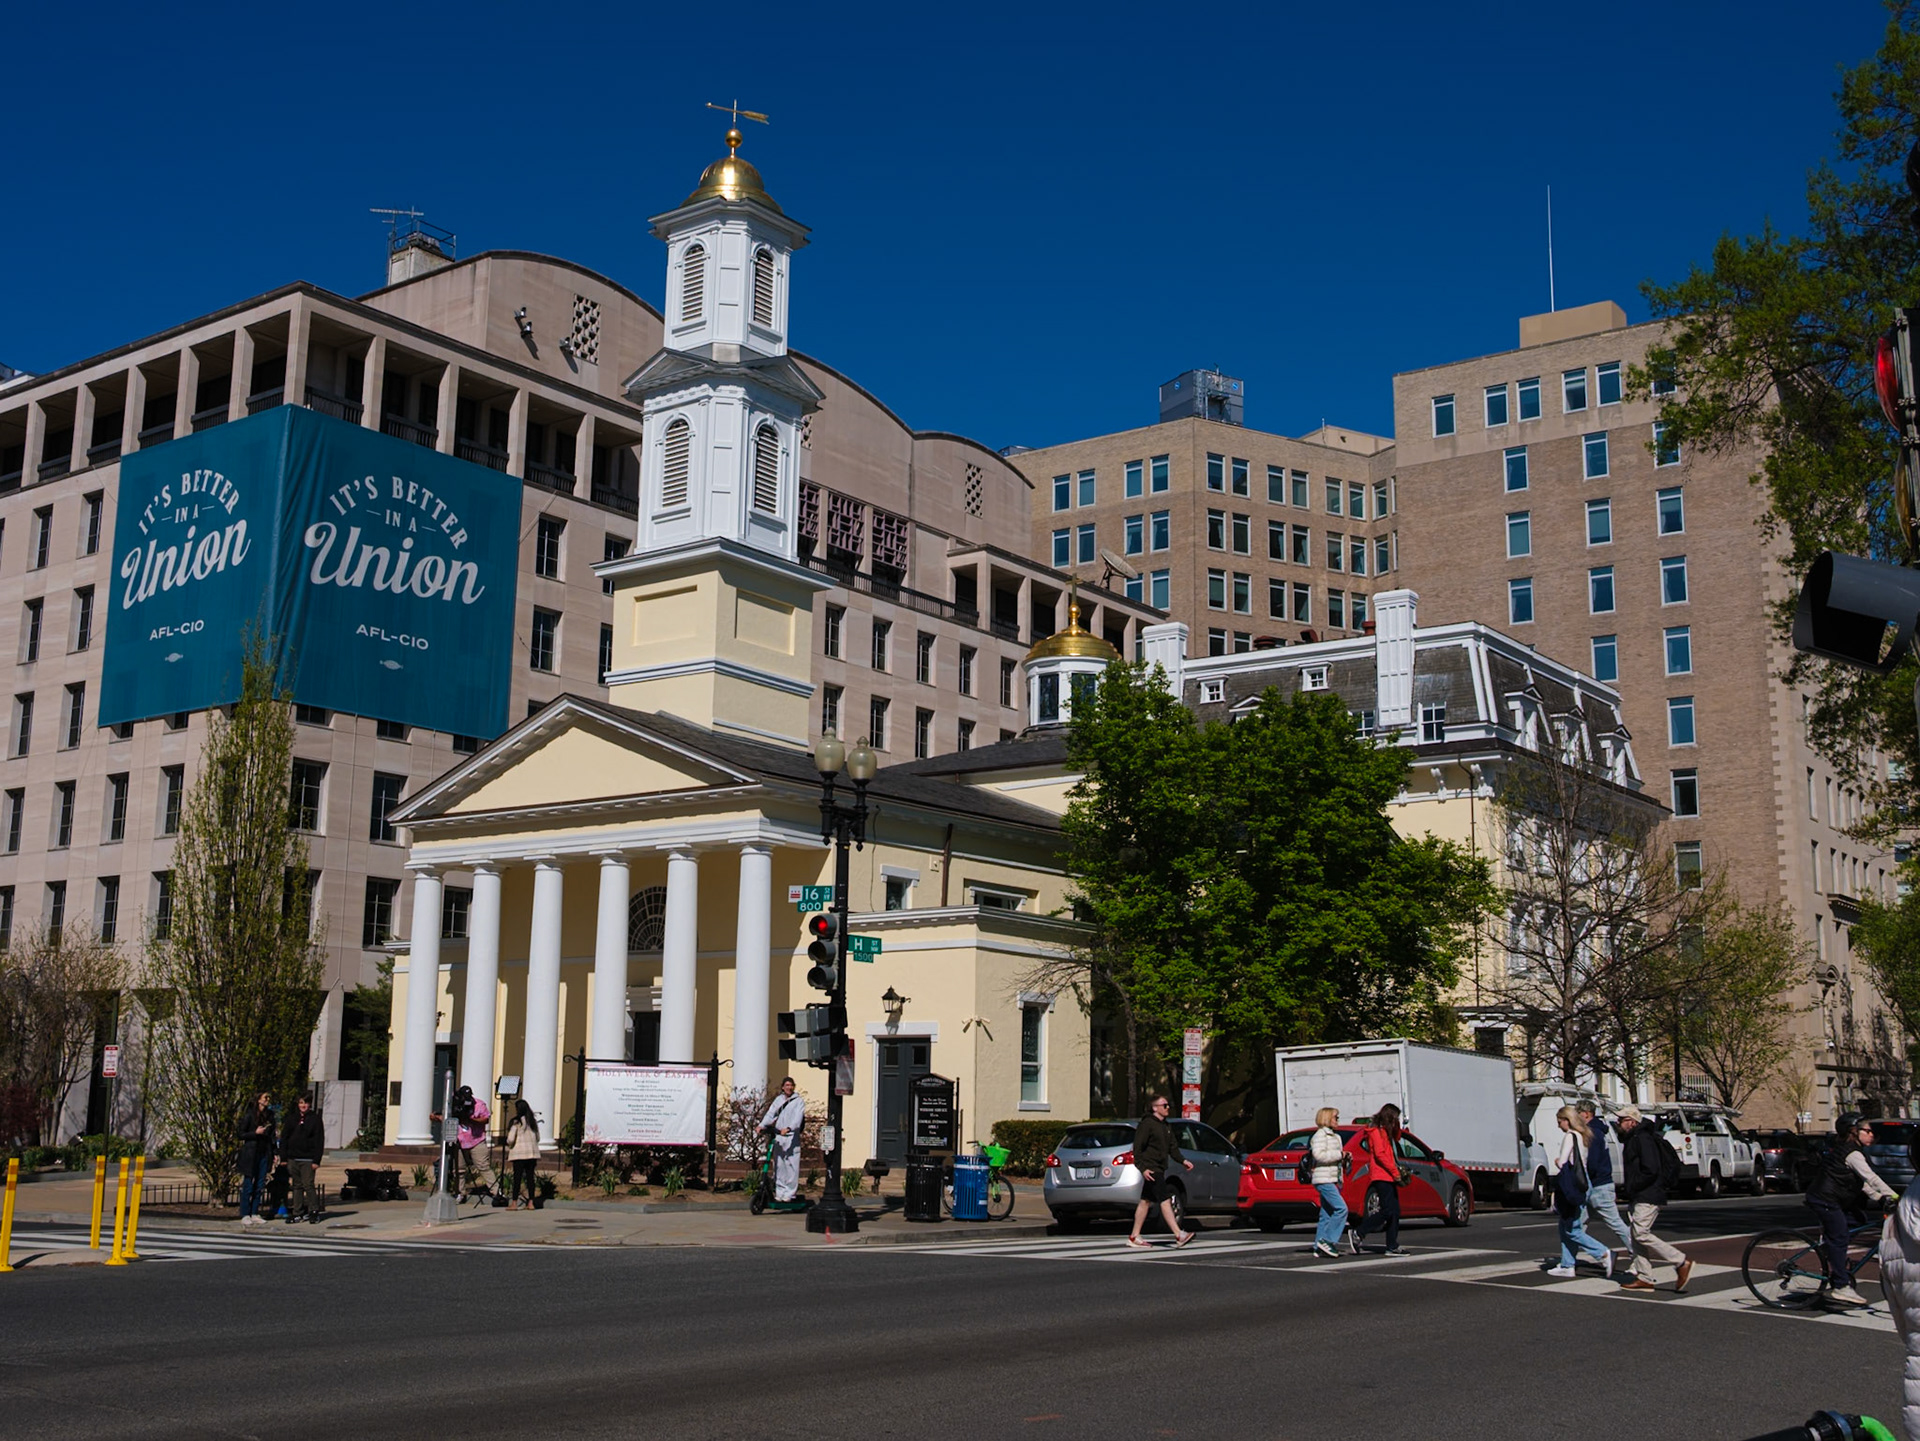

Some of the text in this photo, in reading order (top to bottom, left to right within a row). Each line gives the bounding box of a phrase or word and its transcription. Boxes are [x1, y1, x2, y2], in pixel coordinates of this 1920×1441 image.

[138, 469, 240, 535] IT'S BETTER
[329, 475, 468, 549] IT'S BETTER
[175, 504, 199, 524] IN A
[385, 510, 417, 533] IN A
[121, 518, 252, 610] Union
[303, 521, 486, 605] Union
[149, 619, 204, 641] AFL-CIO
[355, 624, 429, 651] AFL-CIO
[805, 888, 819, 900] 16
[799, 902, 821, 912] 800
[854, 938, 863, 951] H
[854, 952, 873, 962] 1500
[597, 1069, 698, 1080] HOLY WEEK & EASTER
